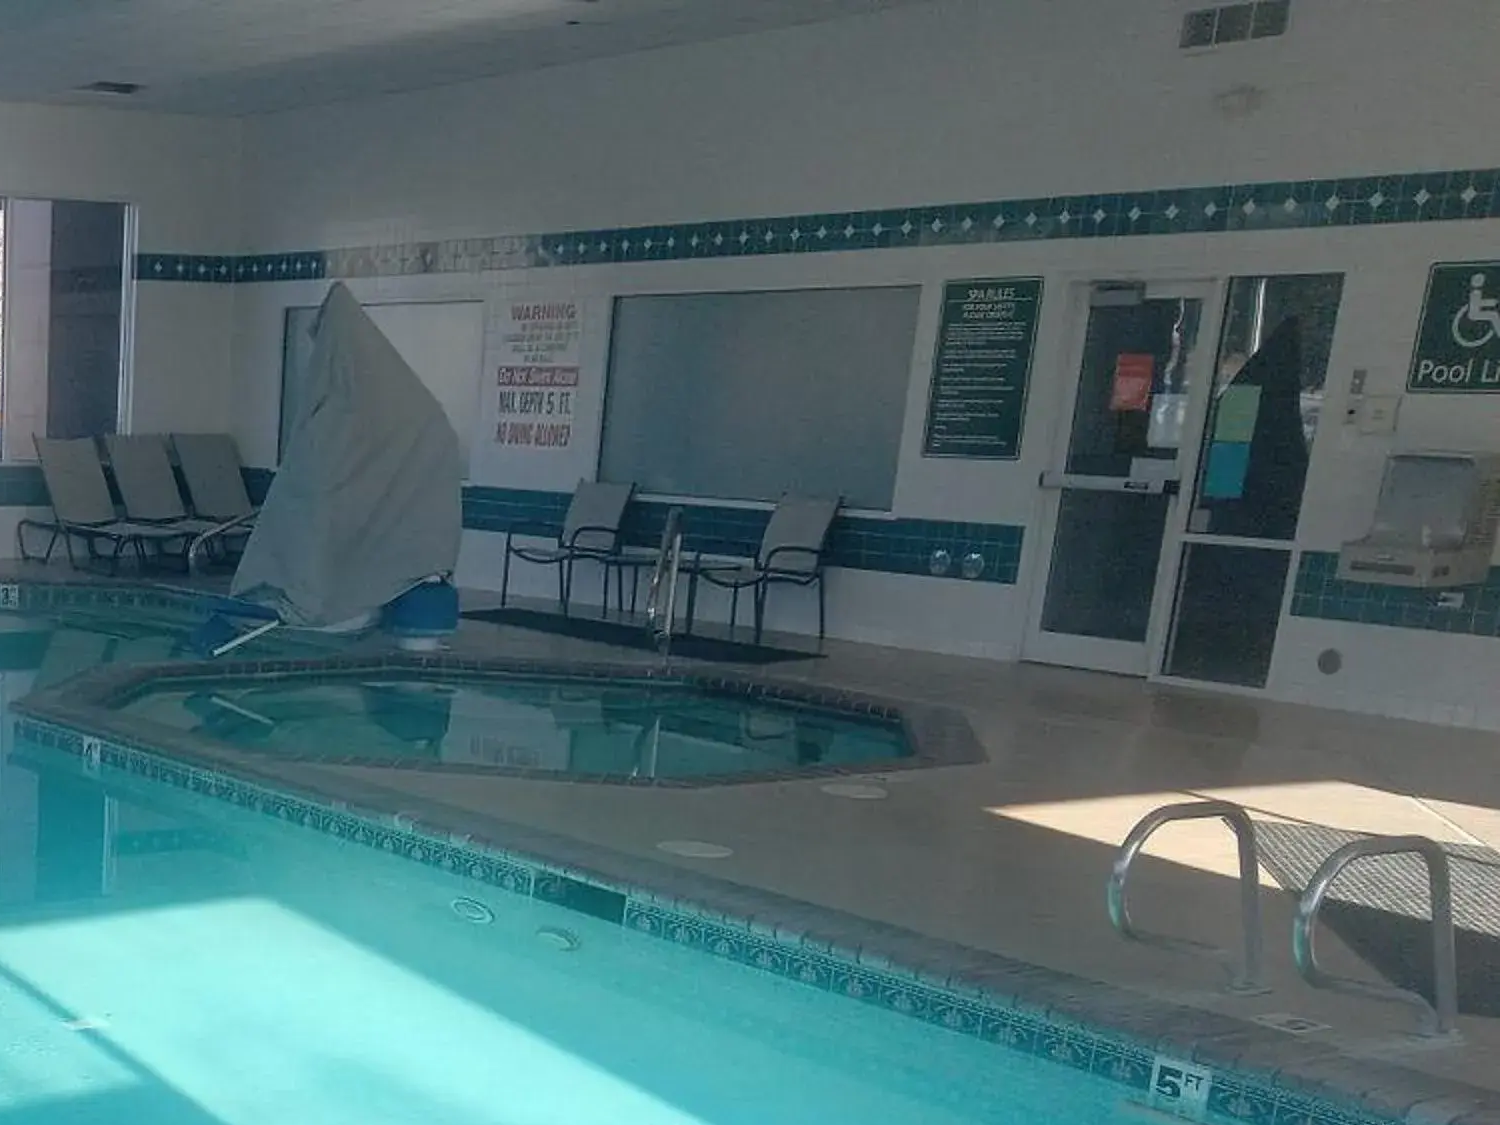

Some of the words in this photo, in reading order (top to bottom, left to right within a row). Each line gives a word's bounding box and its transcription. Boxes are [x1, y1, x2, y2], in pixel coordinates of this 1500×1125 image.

[511, 303, 576, 321] WARNING
[1418, 359, 1474, 383] Pool
[520, 391, 544, 413] DEPTH
[546, 391, 554, 414] 5
[1156, 1064, 1183, 1098] 5
[1184, 1072, 1204, 1091] FT
